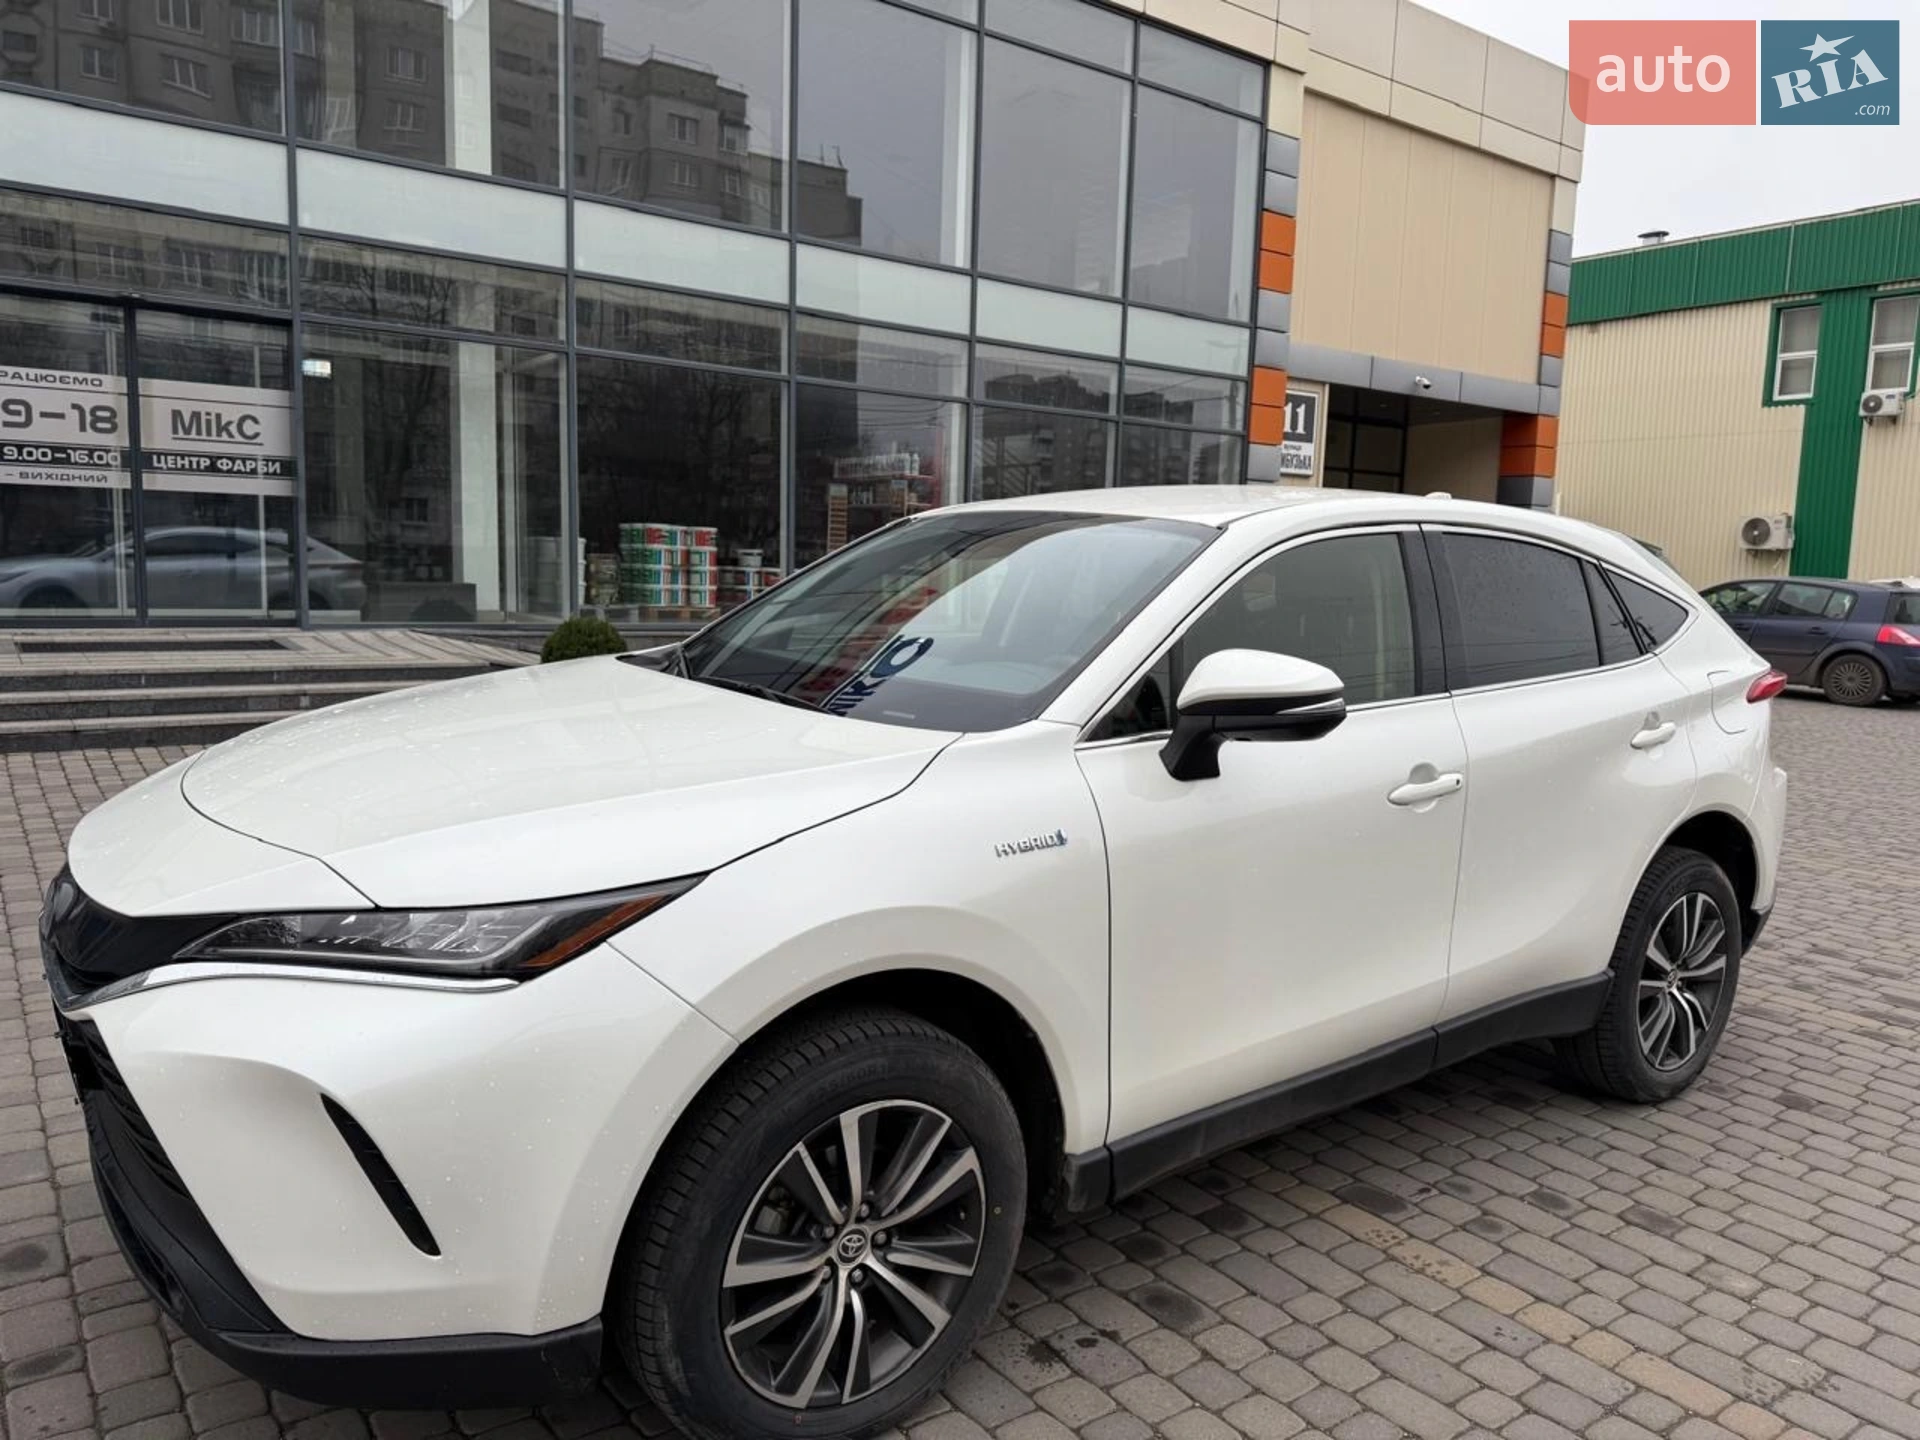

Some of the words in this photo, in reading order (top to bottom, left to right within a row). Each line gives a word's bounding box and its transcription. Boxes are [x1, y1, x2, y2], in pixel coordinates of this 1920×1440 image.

[171, 408, 262, 442] MikC
[152, 454, 211, 470] ЦЕНТР
[216, 457, 281, 475] ФАРБИ
[994, 833, 1057, 858] HYBRID
